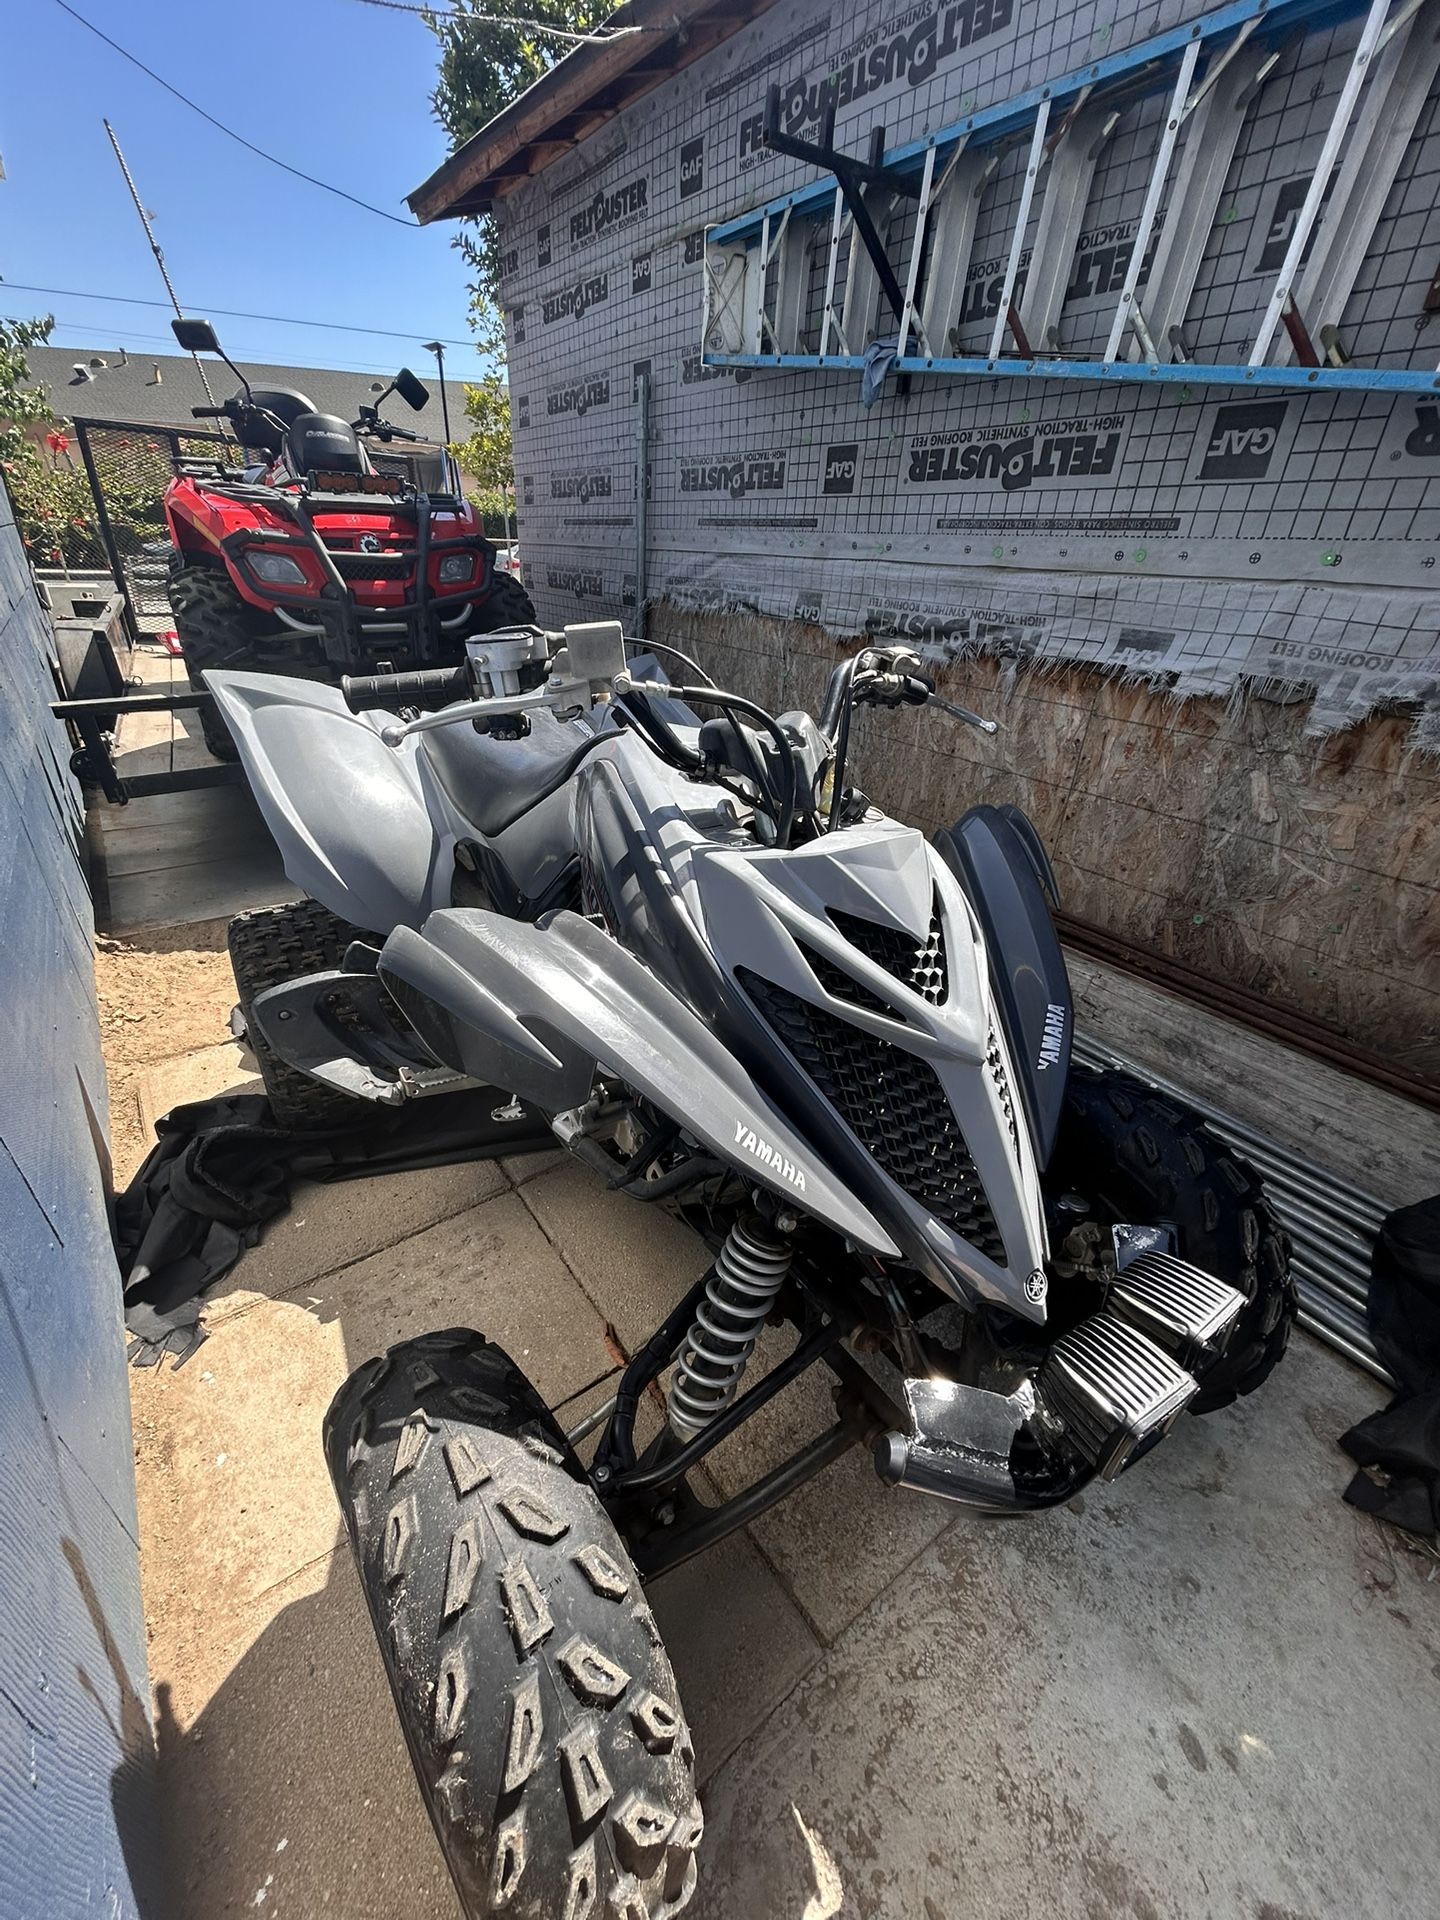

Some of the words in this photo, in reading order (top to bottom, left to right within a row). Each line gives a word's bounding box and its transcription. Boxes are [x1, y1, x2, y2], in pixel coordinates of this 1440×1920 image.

[570, 177, 648, 243] FELTBUSTER
[541, 274, 609, 324] FELTBUSTER
[547, 379, 610, 417] FELTBUSTER
[930, 431, 973, 446] ROOFING
[977, 425, 1030, 442] SYNTHETIC
[1034, 415, 1126, 437] HIGH-TRACTION
[910, 437, 928, 448] FELT
[1206, 427, 1277, 457] GAF
[908, 432, 1121, 490] FELTBUSTER
[550, 475, 612, 504] FELTBUSTER
[680, 460, 786, 498] FELTBUSTER
[885, 600, 920, 613] ROOFING
[922, 603, 968, 618] SYNTHETIC
[970, 609, 1047, 628] HIGH-TRACTION
[1268, 641, 1303, 659] FELT
[1307, 647, 1395, 671] ROOFING
[1037, 1003, 1066, 1070] YAMAHA
[734, 1120, 806, 1192] YAMAHA
